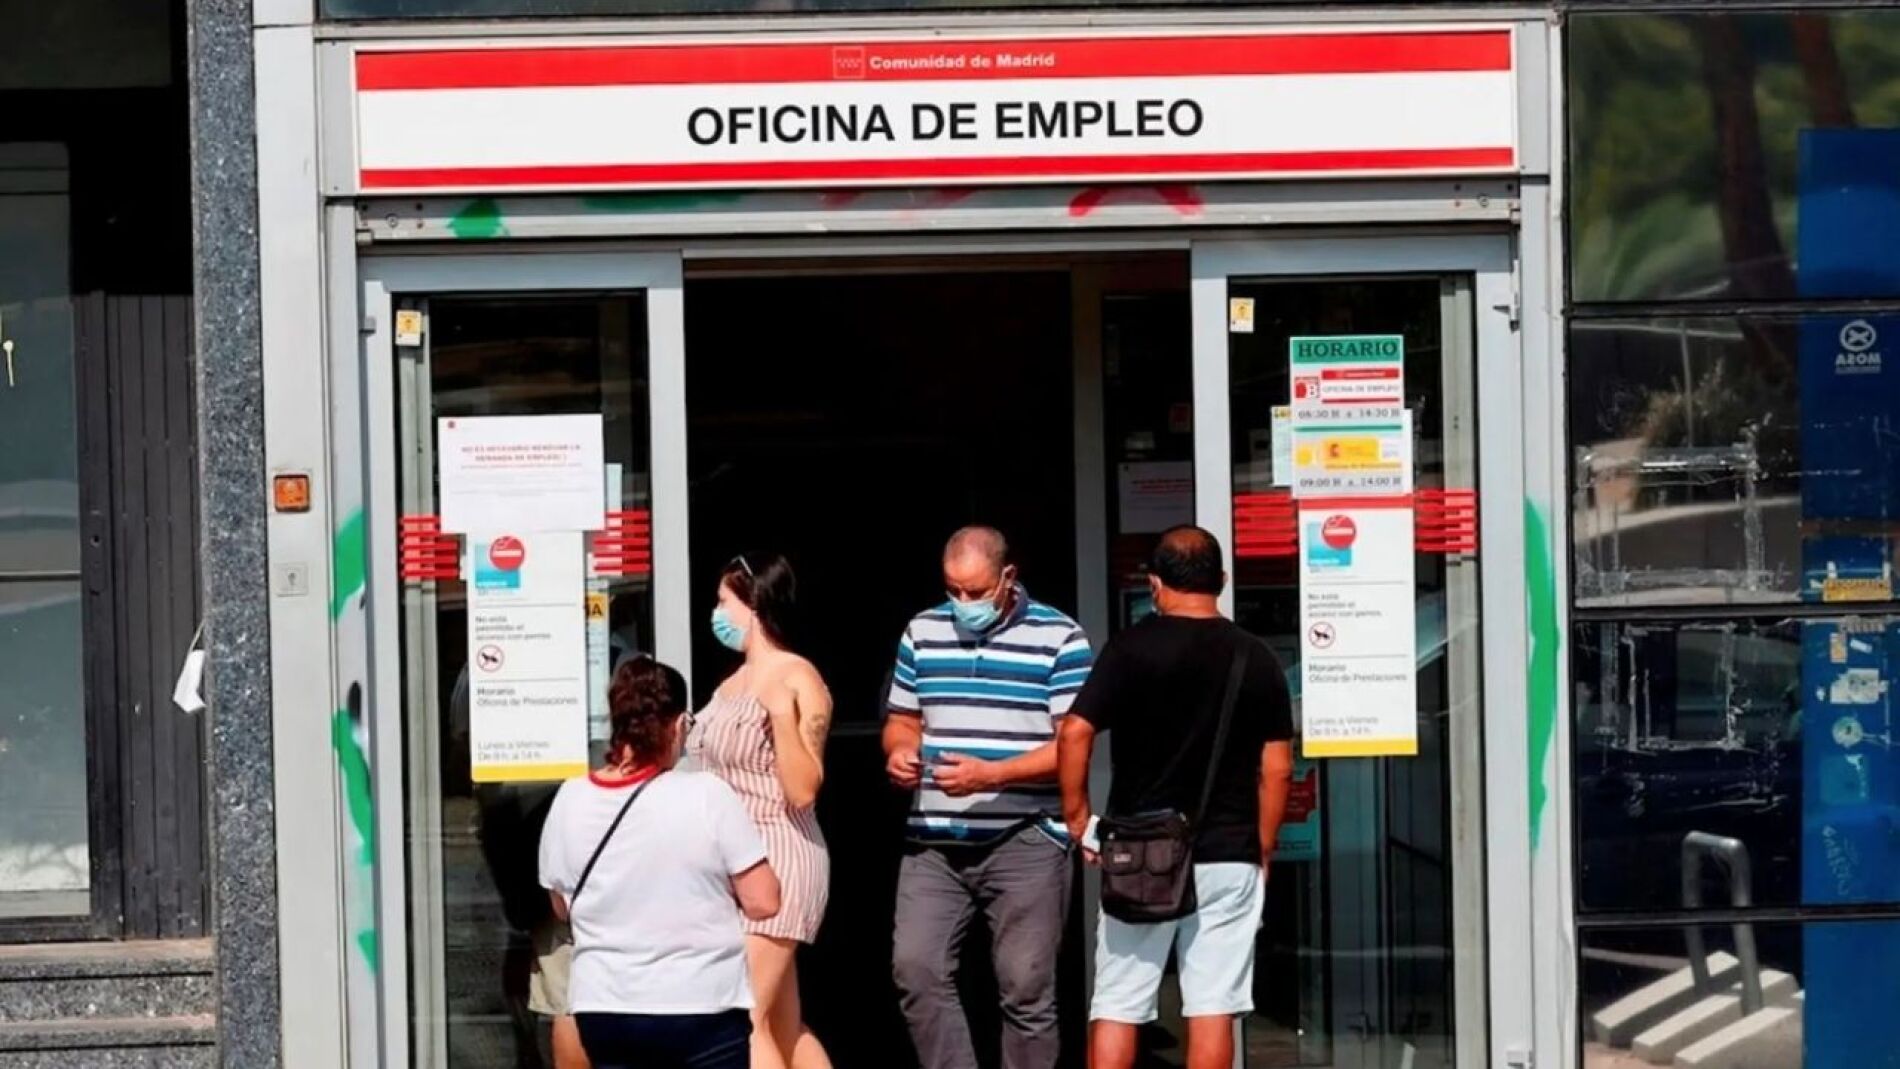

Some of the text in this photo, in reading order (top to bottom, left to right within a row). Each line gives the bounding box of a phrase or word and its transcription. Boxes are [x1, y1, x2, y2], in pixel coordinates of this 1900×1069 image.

[870, 53, 1055, 69] Comunidad de Madrid
[687, 98, 1204, 145] OFICINA DE EMPLEO
[1298, 340, 1398, 358] HORARIO
[1322, 385, 1353, 393] OFICINA
[1367, 384, 1400, 392] EMPLEO
[1300, 478, 1330, 487] 09:00
[1361, 477, 1390, 486] 14:00
[1308, 664, 1346, 672] Horario
[477, 687, 516, 696] Horario
